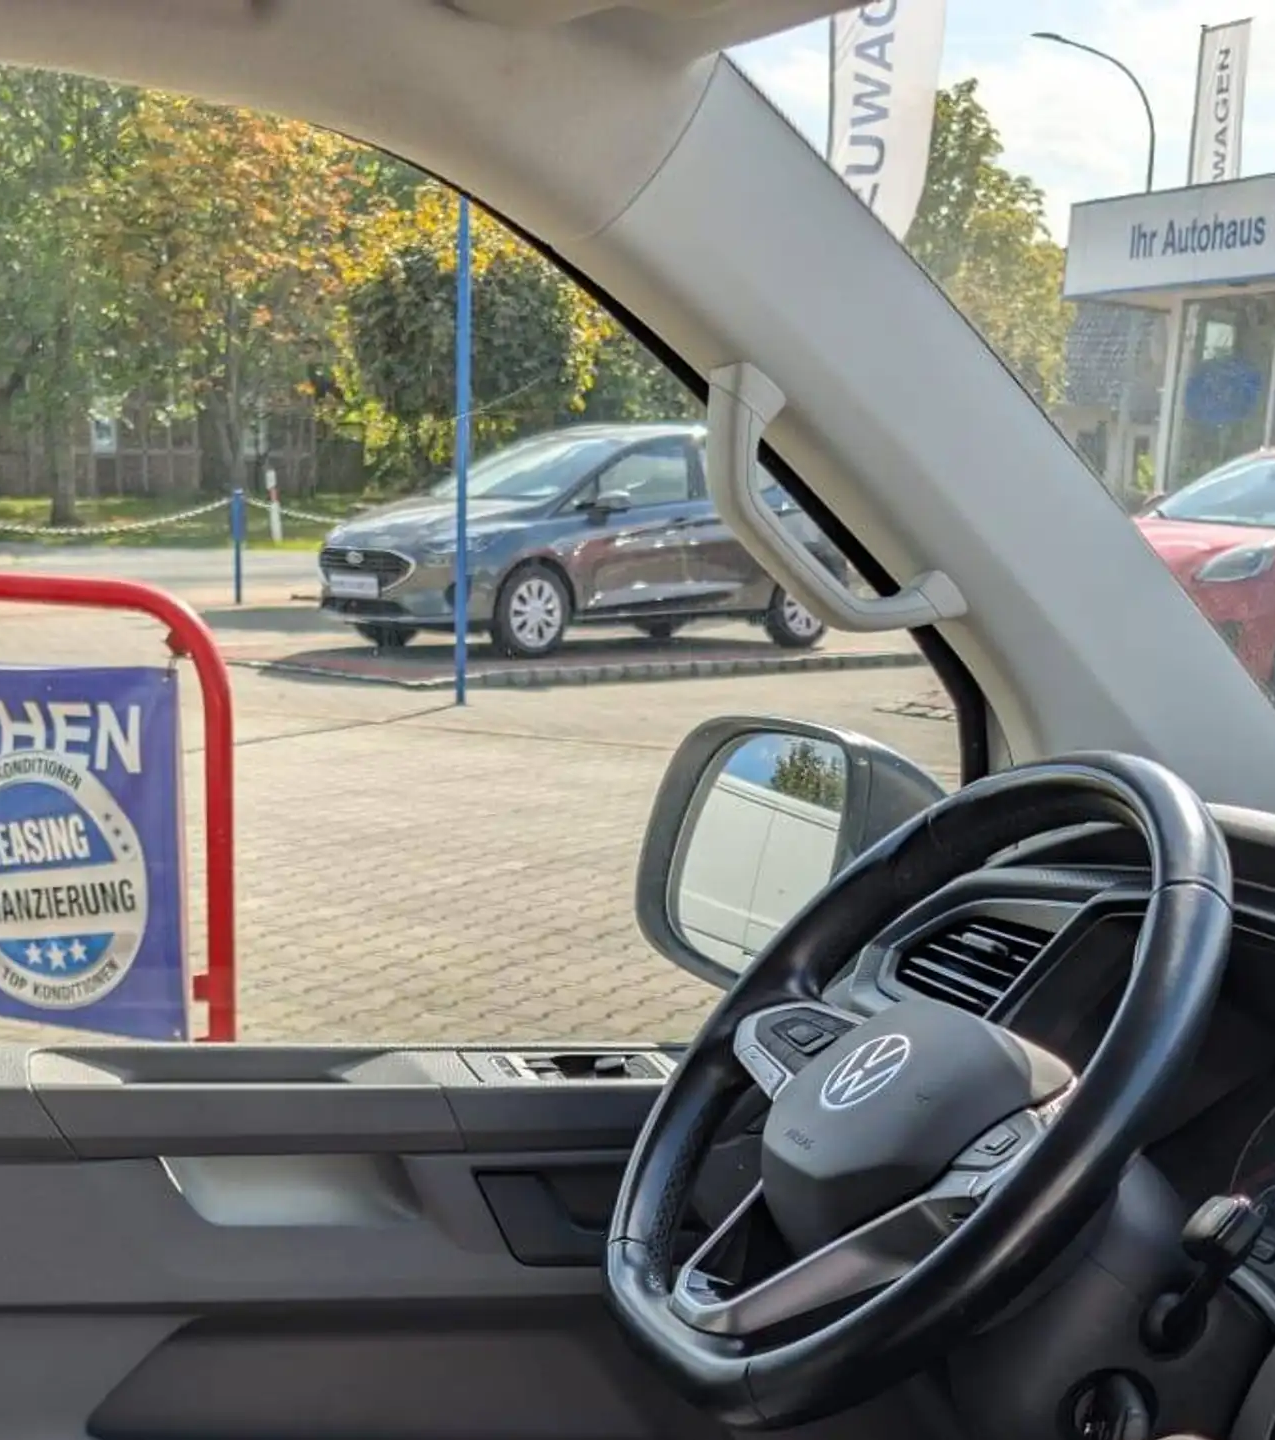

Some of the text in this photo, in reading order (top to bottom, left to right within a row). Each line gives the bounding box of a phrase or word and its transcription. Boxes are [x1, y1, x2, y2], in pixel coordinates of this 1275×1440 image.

[1128, 214, 1268, 260] Ihr Autohaus
[1, 956, 122, 1003] TOP KONDITIONEN
